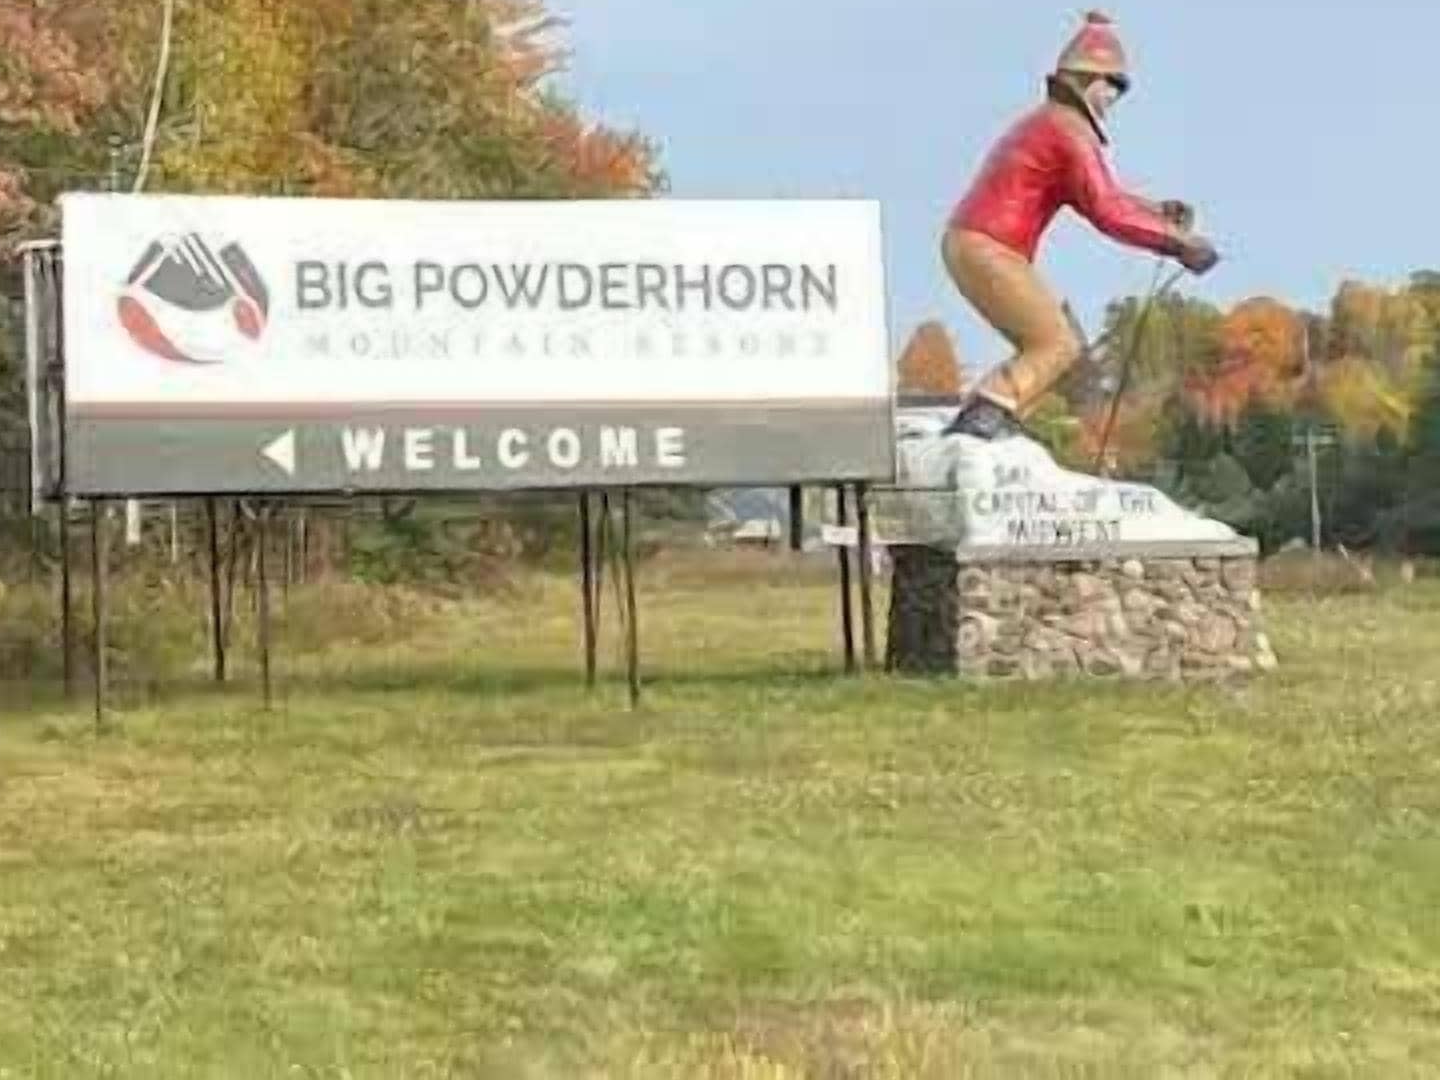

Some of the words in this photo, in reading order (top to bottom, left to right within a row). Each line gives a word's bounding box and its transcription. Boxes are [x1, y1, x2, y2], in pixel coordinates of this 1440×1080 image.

[295, 260, 394, 310] BIG
[414, 261, 839, 312] POWDERHORN
[340, 425, 688, 470] WELCOME
